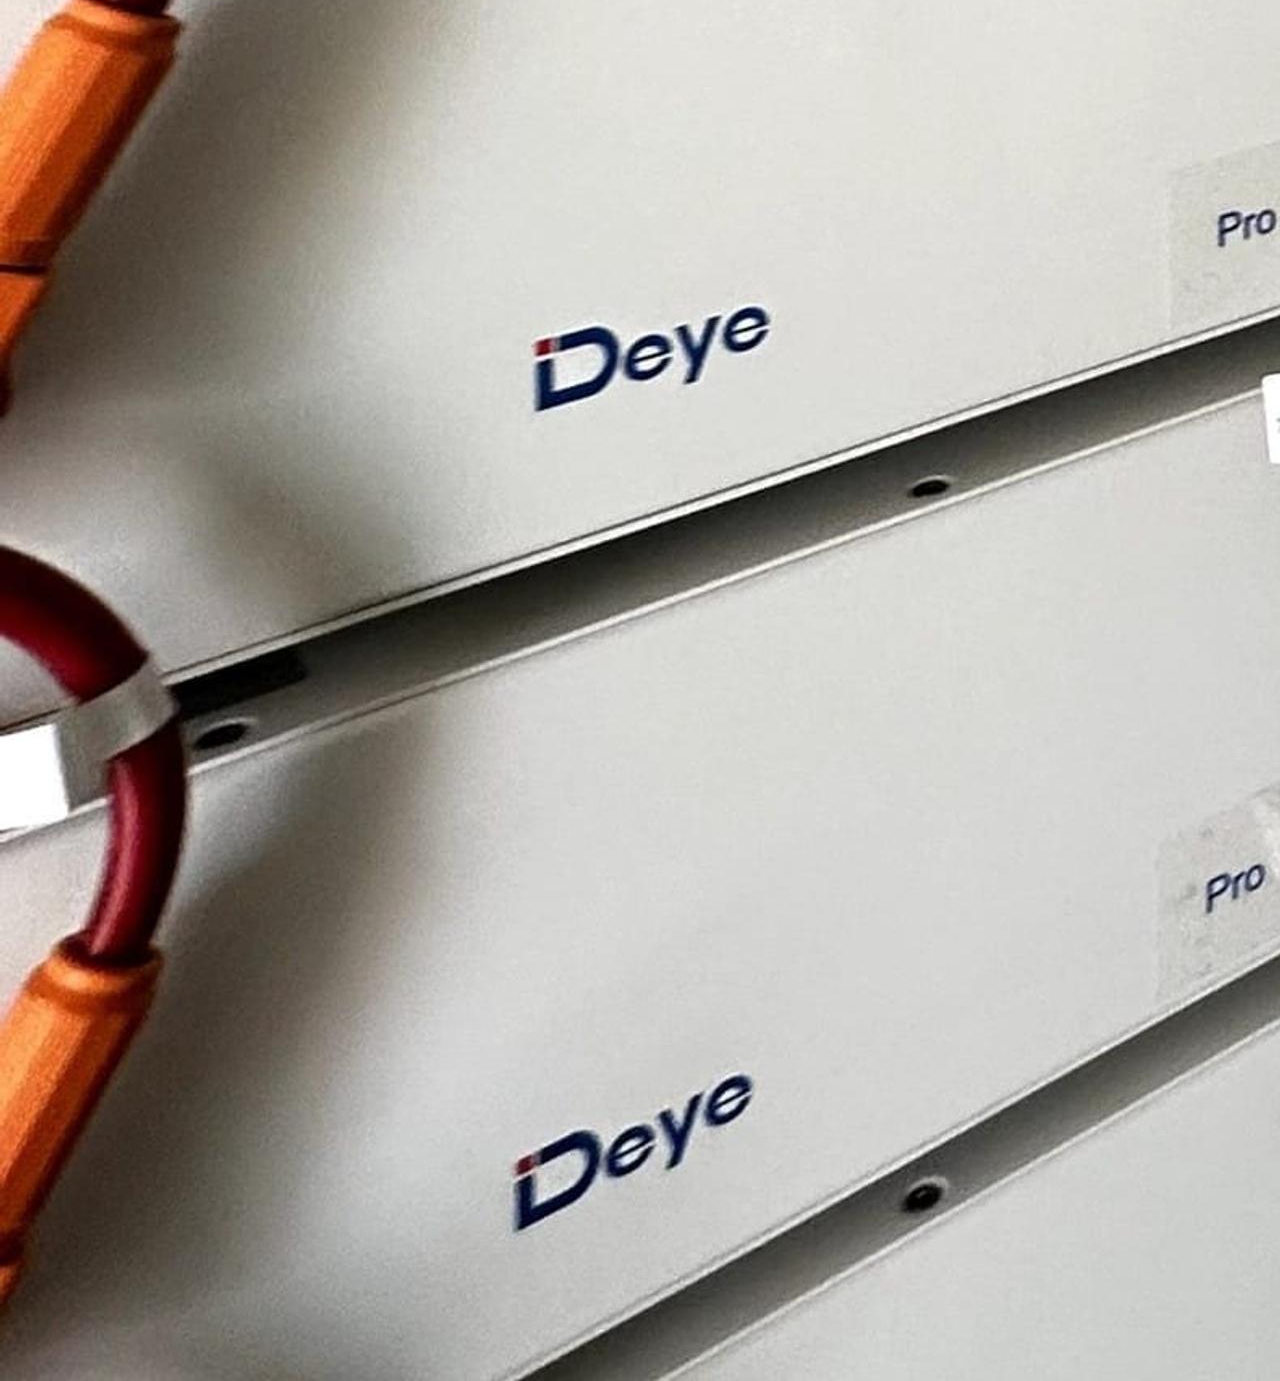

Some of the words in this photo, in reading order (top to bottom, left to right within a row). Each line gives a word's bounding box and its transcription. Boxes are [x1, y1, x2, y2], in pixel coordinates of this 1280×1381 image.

[1217, 208, 1277, 247] Pro
[533, 302, 770, 412] Deye
[1205, 862, 1265, 912] Pro
[512, 1070, 755, 1232] Deye
